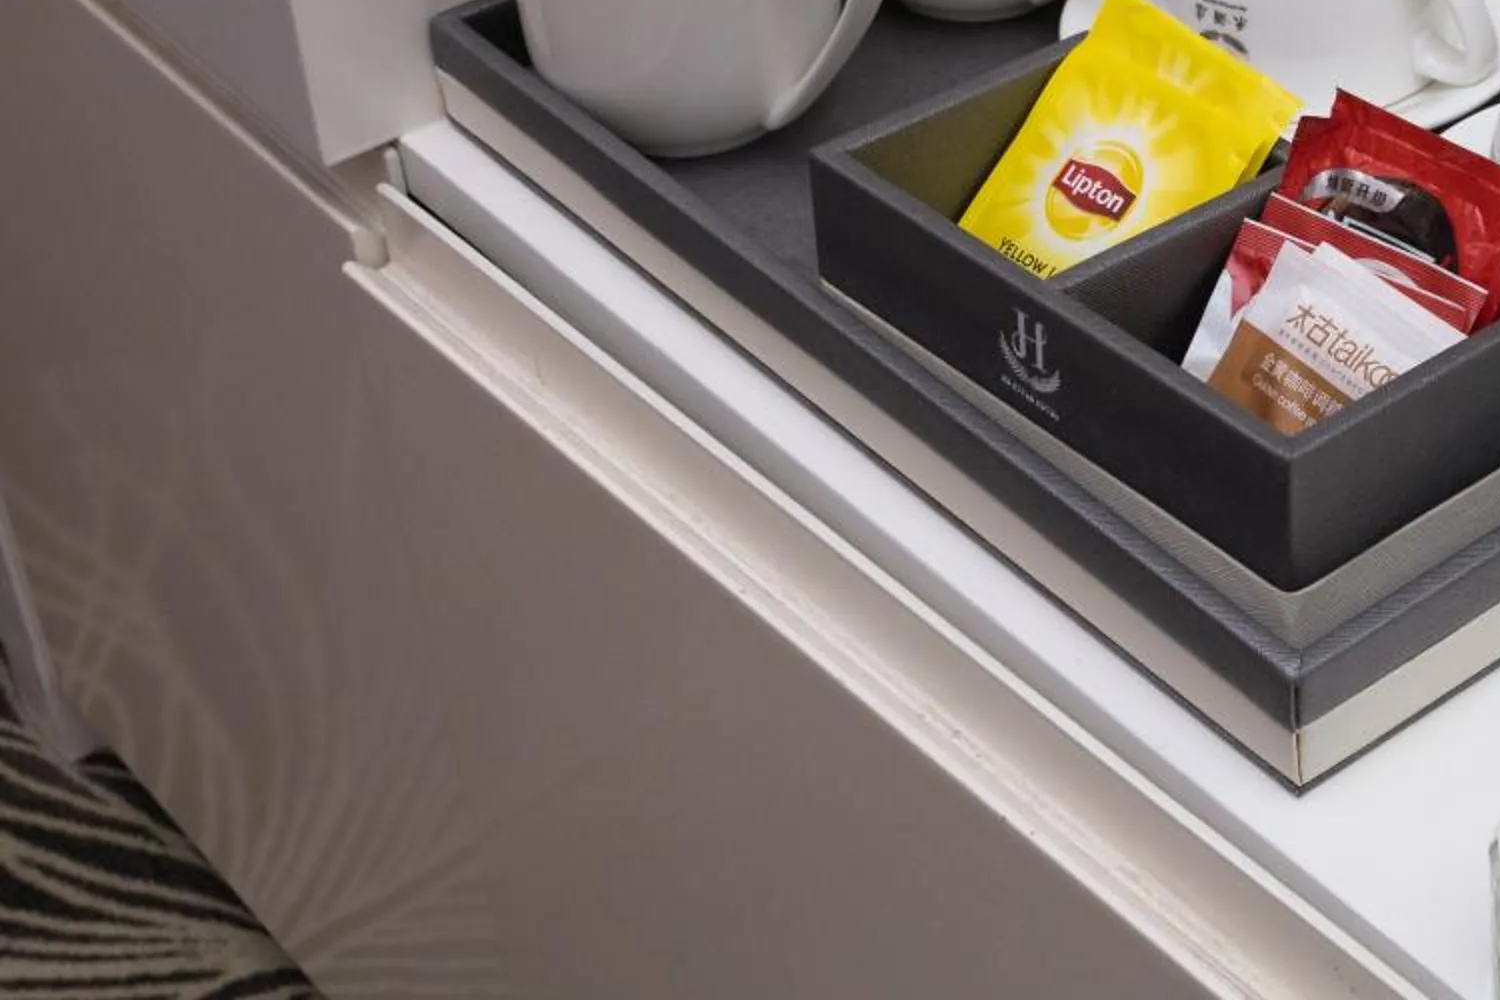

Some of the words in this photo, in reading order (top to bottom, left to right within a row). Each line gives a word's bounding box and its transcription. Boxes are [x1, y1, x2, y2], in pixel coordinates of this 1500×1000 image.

[1061, 164, 1126, 214] Lipton
[997, 236, 1049, 274] YELLOW
[1286, 303, 1339, 348] 太古
